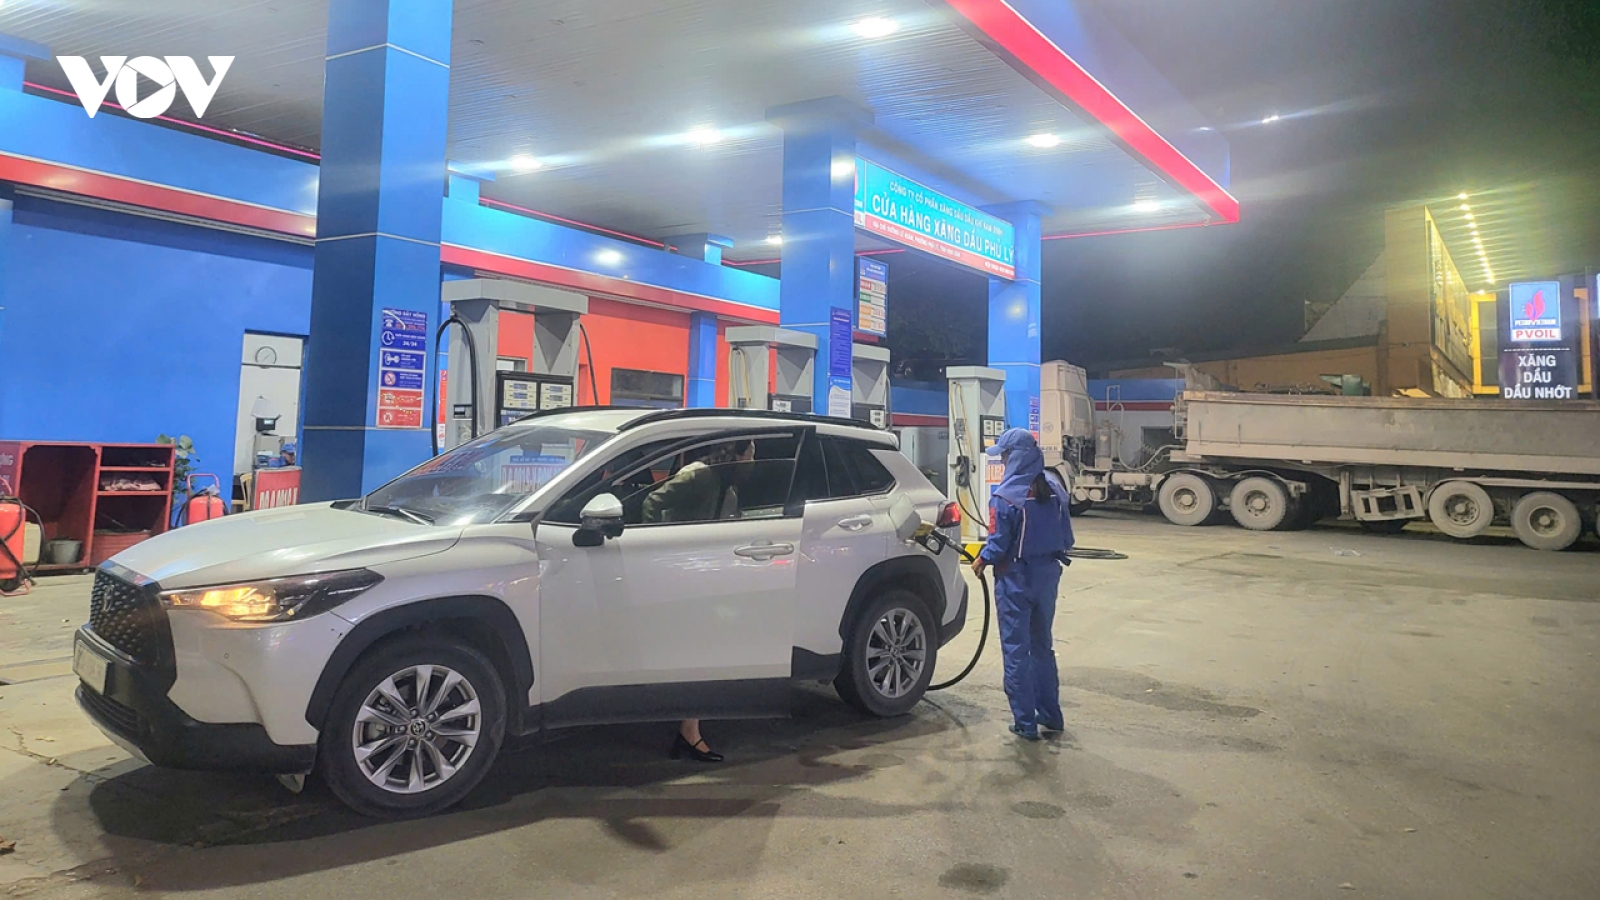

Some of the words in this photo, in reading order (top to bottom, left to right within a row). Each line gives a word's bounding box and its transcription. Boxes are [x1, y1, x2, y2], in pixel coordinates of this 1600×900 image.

[872, 192, 897, 220] CỬA
[900, 204, 931, 233] HÀNG
[934, 217, 961, 244] XĂNG
[963, 228, 982, 251] DẦU
[984, 238, 1002, 259] PHỦ
[1004, 245, 1015, 263] LÝ
[1515, 329, 1556, 339] PVOIL
[1518, 353, 1556, 367] XĂNG
[1523, 367, 1551, 383] DẦU
[1504, 383, 1531, 399] DẦU
[1535, 384, 1572, 399] NHỚT
